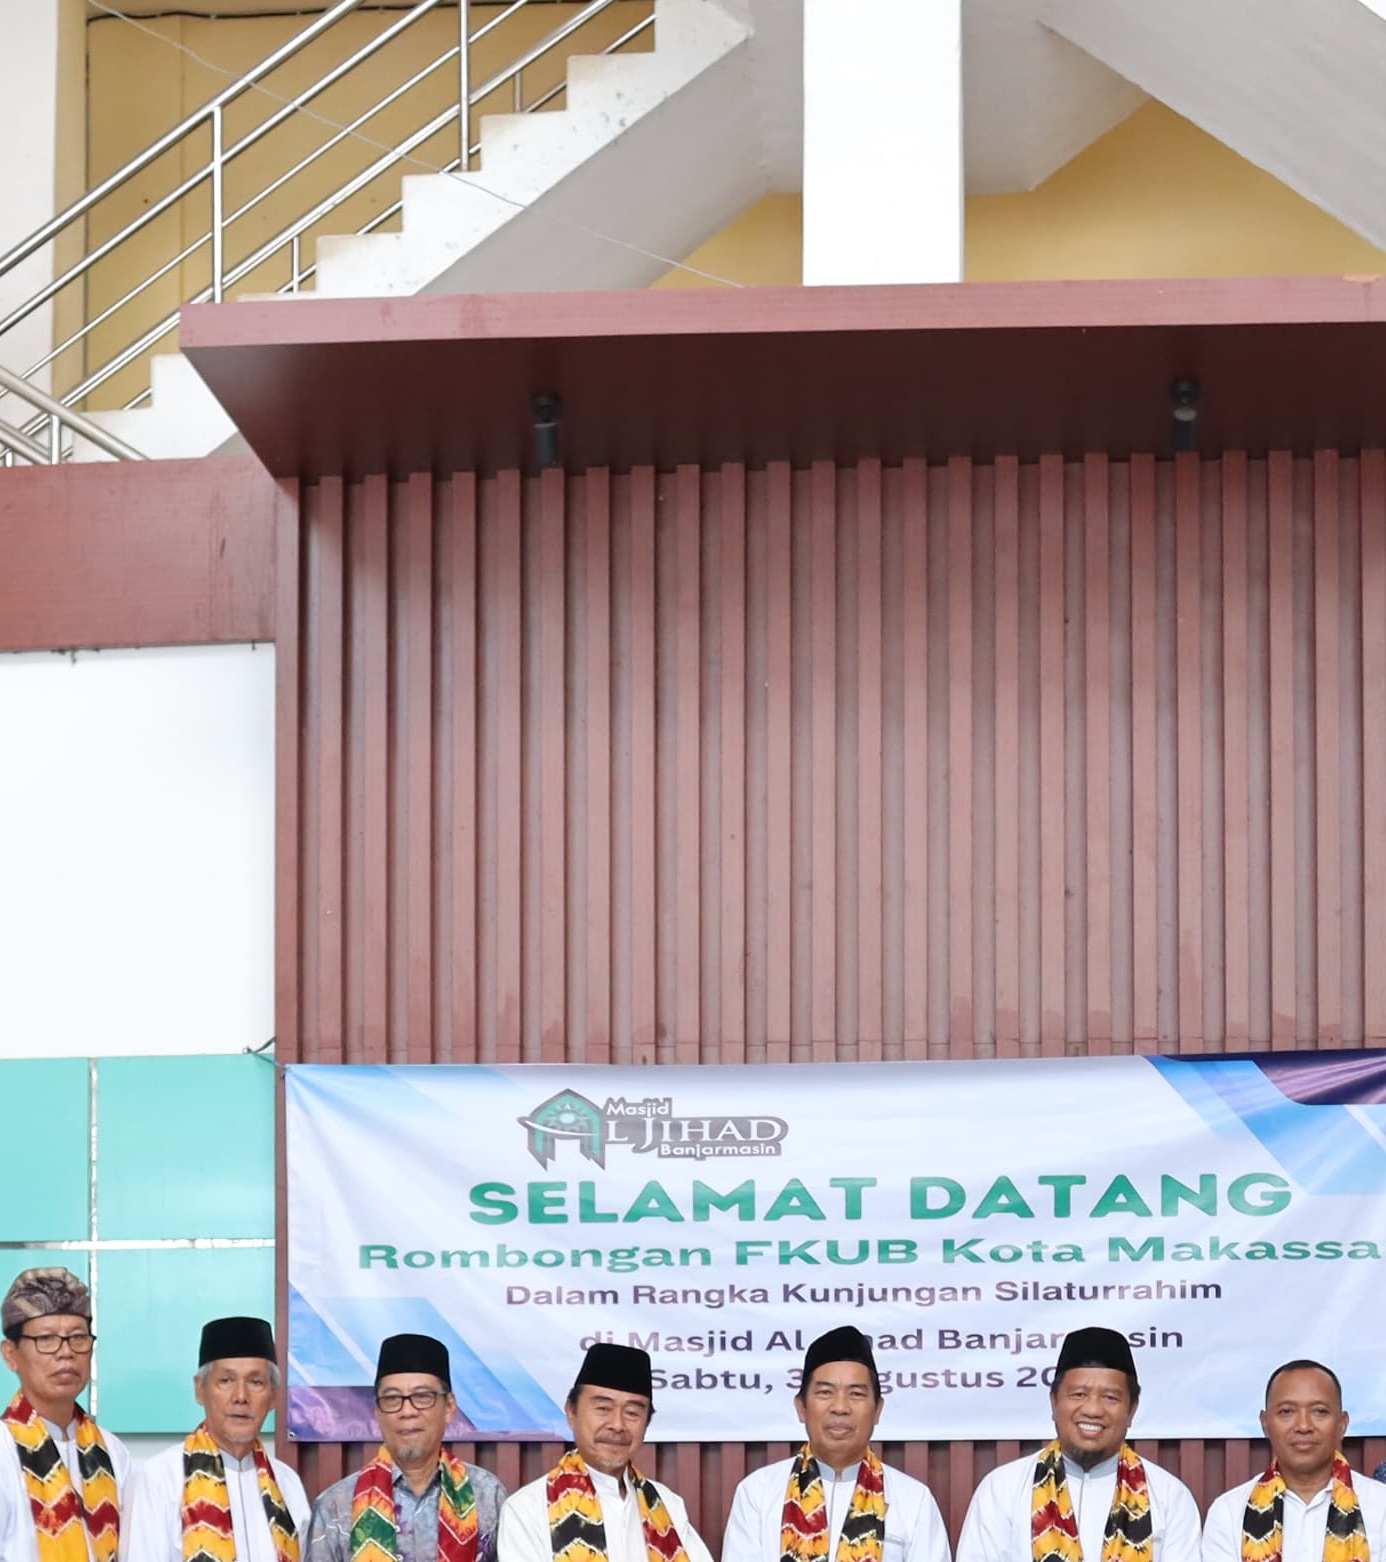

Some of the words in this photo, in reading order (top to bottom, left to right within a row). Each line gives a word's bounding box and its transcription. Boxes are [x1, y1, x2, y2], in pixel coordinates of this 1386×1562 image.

[606, 1101, 670, 1117] Masjid
[638, 1117, 782, 1150] JIHAD
[661, 1142, 776, 1158] Banjarmasin
[469, 1177, 878, 1225] SELAMAT
[910, 1172, 1292, 1220] DATANG
[358, 1243, 712, 1273] Rombongan
[735, 1239, 919, 1265] FKUB
[942, 1237, 1085, 1264] Kota
[506, 1285, 619, 1305] Dalam
[632, 1284, 770, 1309] Rangka
[782, 1282, 982, 1308] Kunjungan
[995, 1279, 1223, 1301] Silaturrahim
[628, 1329, 753, 1358] Masjid
[938, 1327, 1183, 1355] Banjarsin
[651, 1368, 773, 1395] Sabtu,
[877, 1366, 1005, 1394] gustus
[1016, 1366, 1058, 1388] 20
